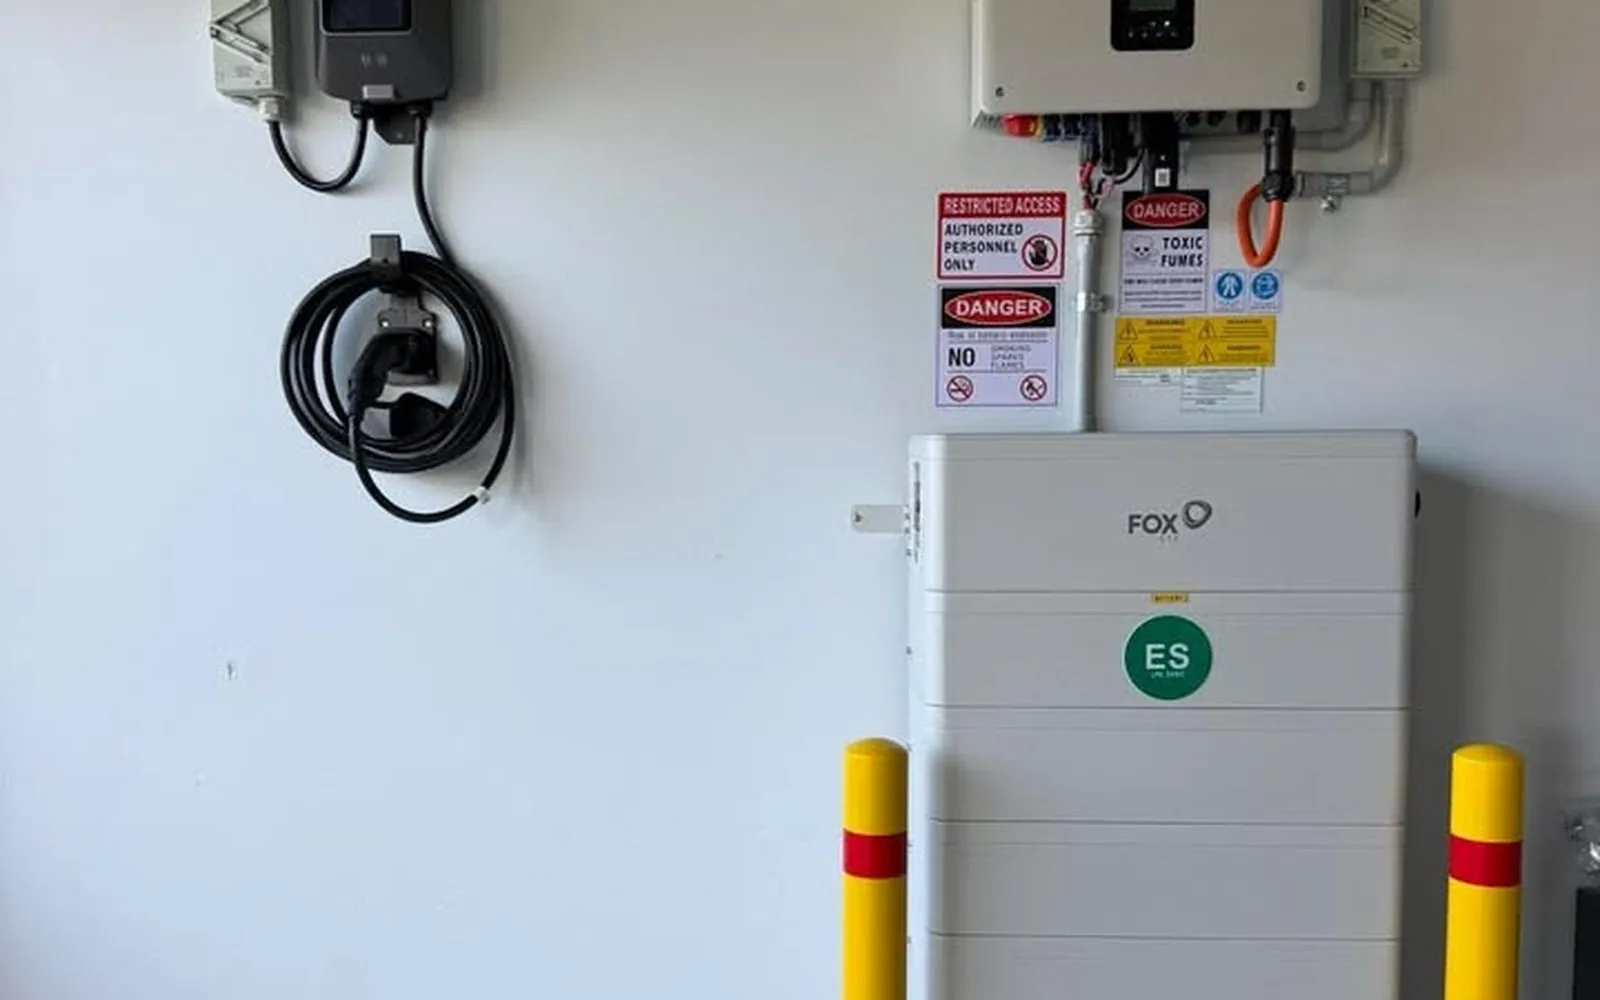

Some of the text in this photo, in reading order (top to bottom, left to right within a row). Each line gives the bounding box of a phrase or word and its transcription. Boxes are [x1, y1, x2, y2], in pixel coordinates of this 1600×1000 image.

[943, 196, 1061, 215] RESTRICTED ACCESS
[1133, 201, 1200, 218] DANGER
[944, 223, 1023, 236] AUTHORIZED
[944, 240, 1018, 253] PERSONNEL
[1162, 236, 1203, 250] TOXIC
[944, 258, 975, 271] ONLY
[1161, 253, 1203, 268] FUMES
[956, 299, 1043, 316] DANGER
[948, 347, 975, 367] NO
[1128, 514, 1178, 534] FOX
[1146, 643, 1190, 669] ES
